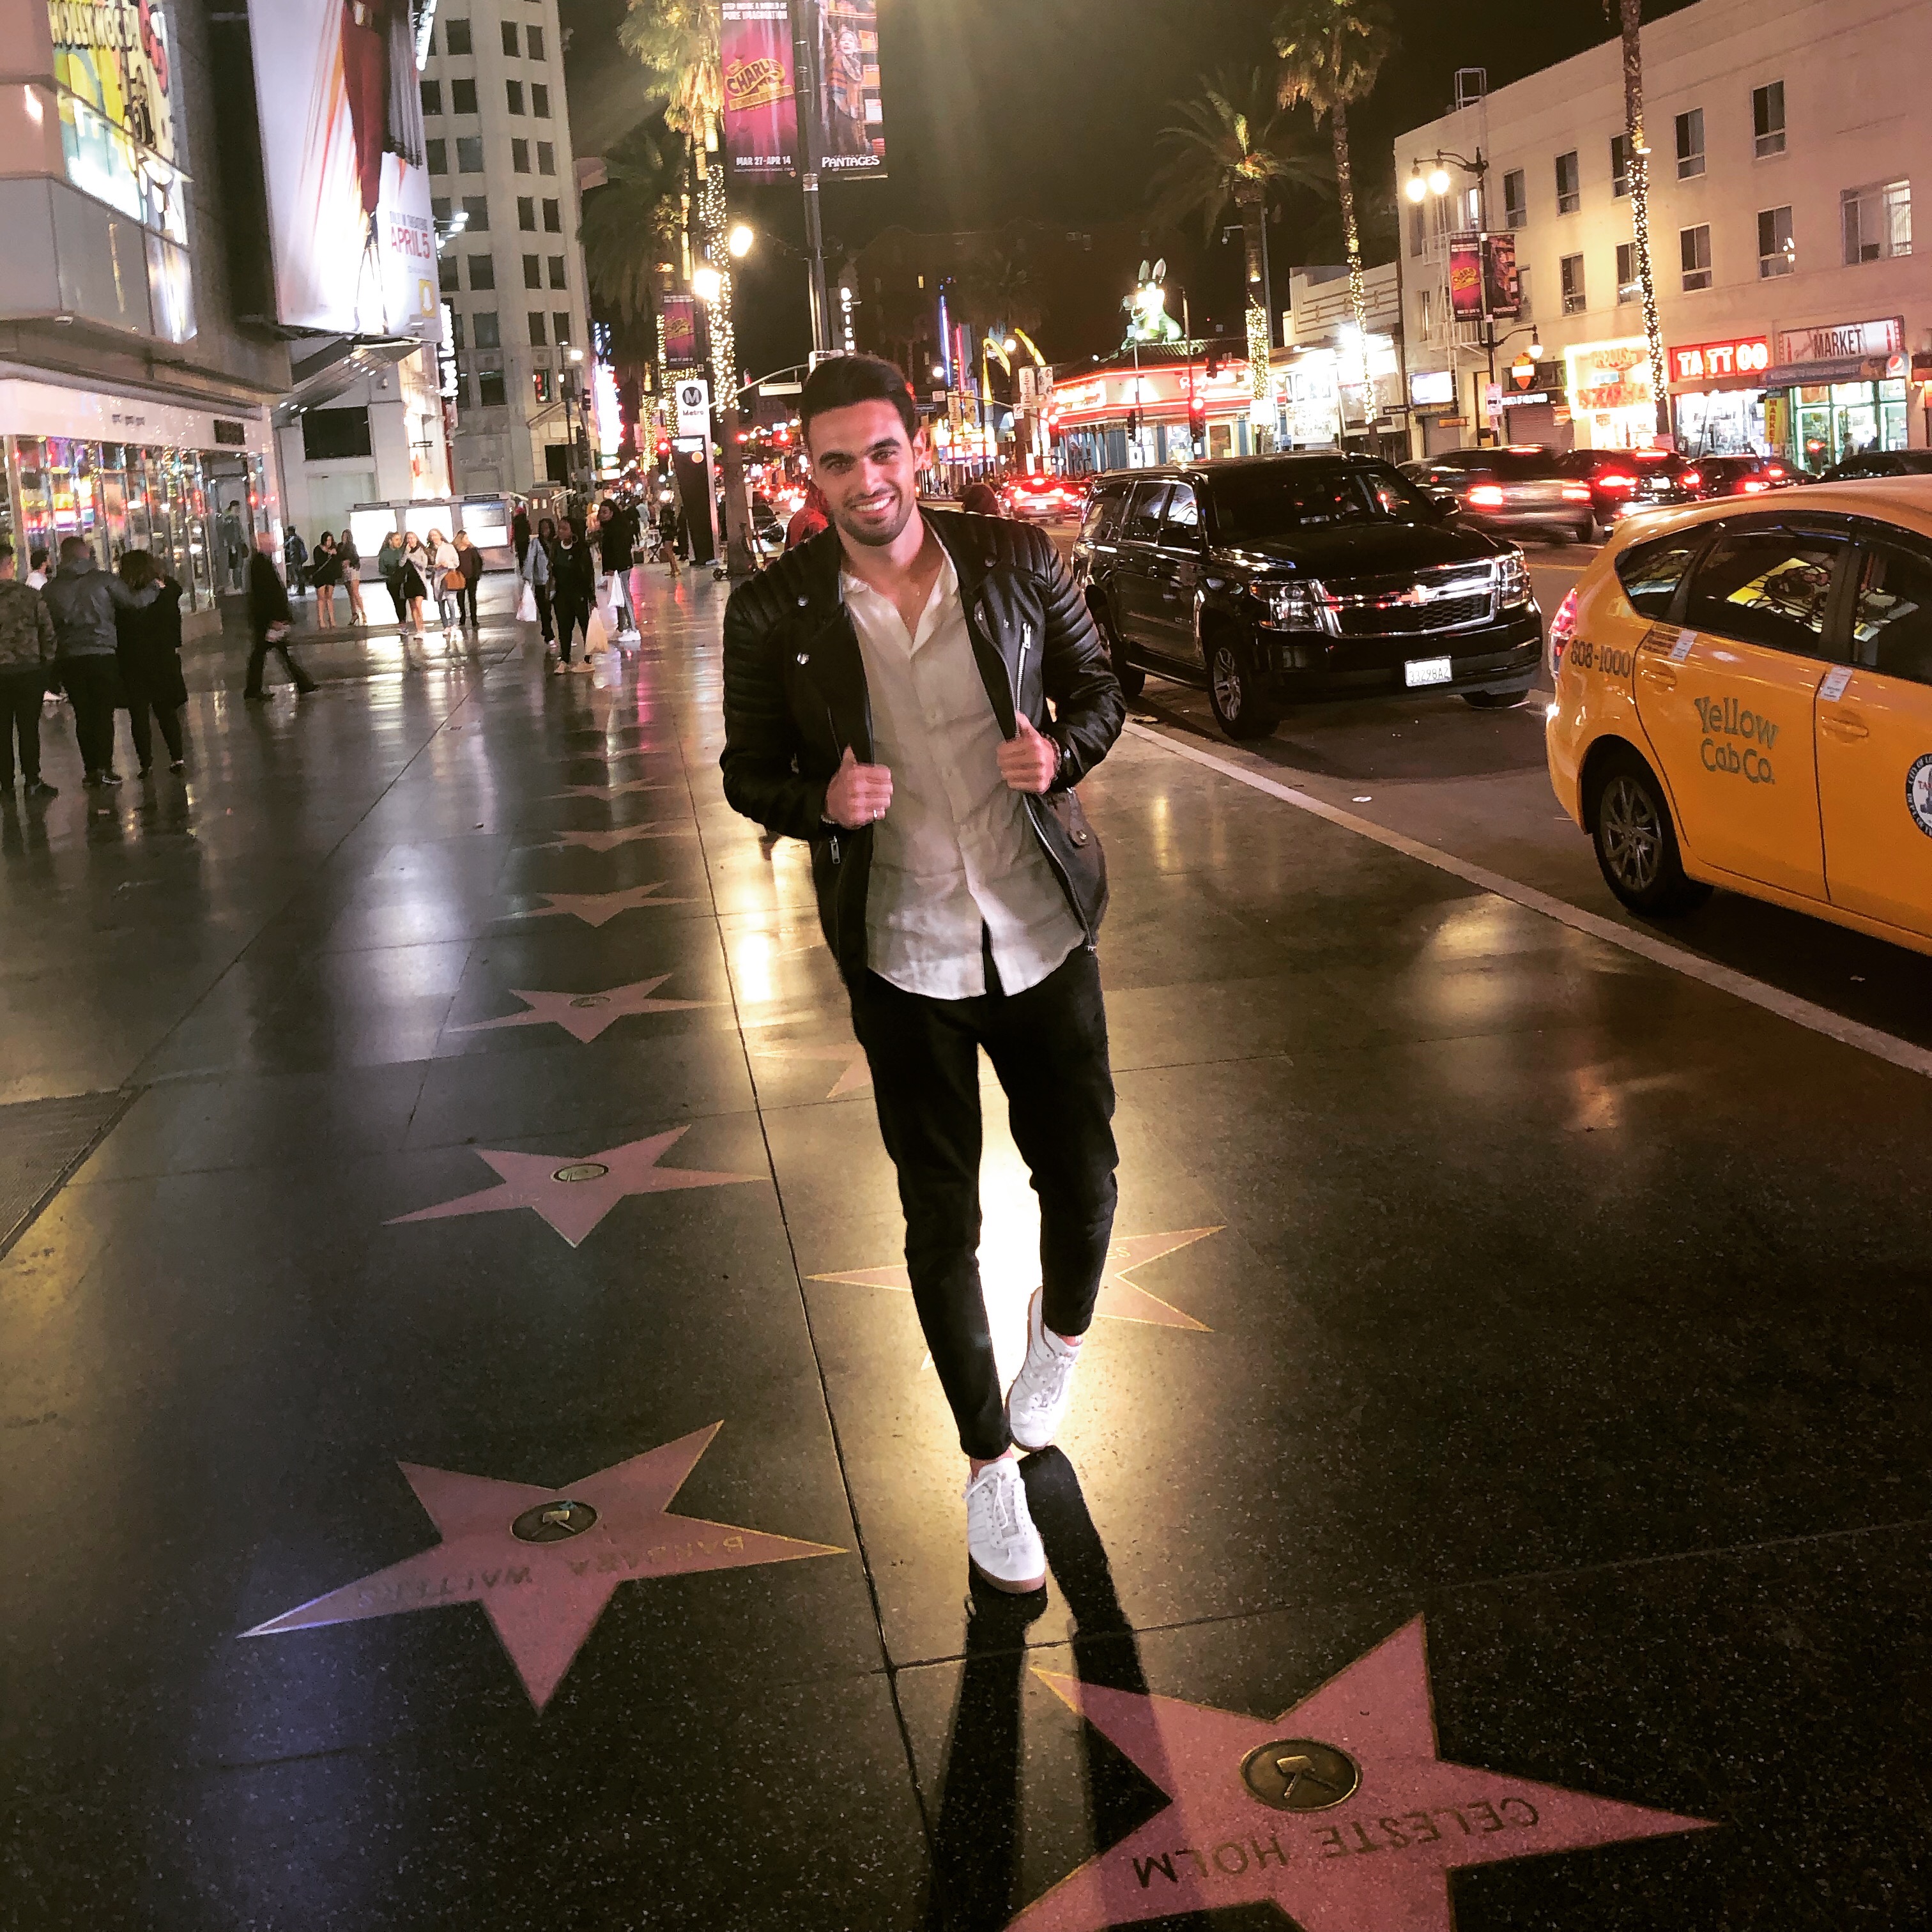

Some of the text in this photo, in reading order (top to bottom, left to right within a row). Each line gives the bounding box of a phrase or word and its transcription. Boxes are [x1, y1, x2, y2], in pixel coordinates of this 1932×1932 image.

[736, 157, 753, 165] MAR
[782, 155, 791, 164] 14
[822, 155, 880, 167] PANTAGES
[391, 226, 431, 259] APRIL 5
[1677, 342, 1768, 376] TATTOO
[1814, 329, 1862, 358] MARKET
[1694, 696, 1779, 750] Yellow
[1701, 738, 1740, 774] Cab
[1314, 1797, 1540, 1858] CELESTE
[1132, 1836, 1288, 1889] HOLM
